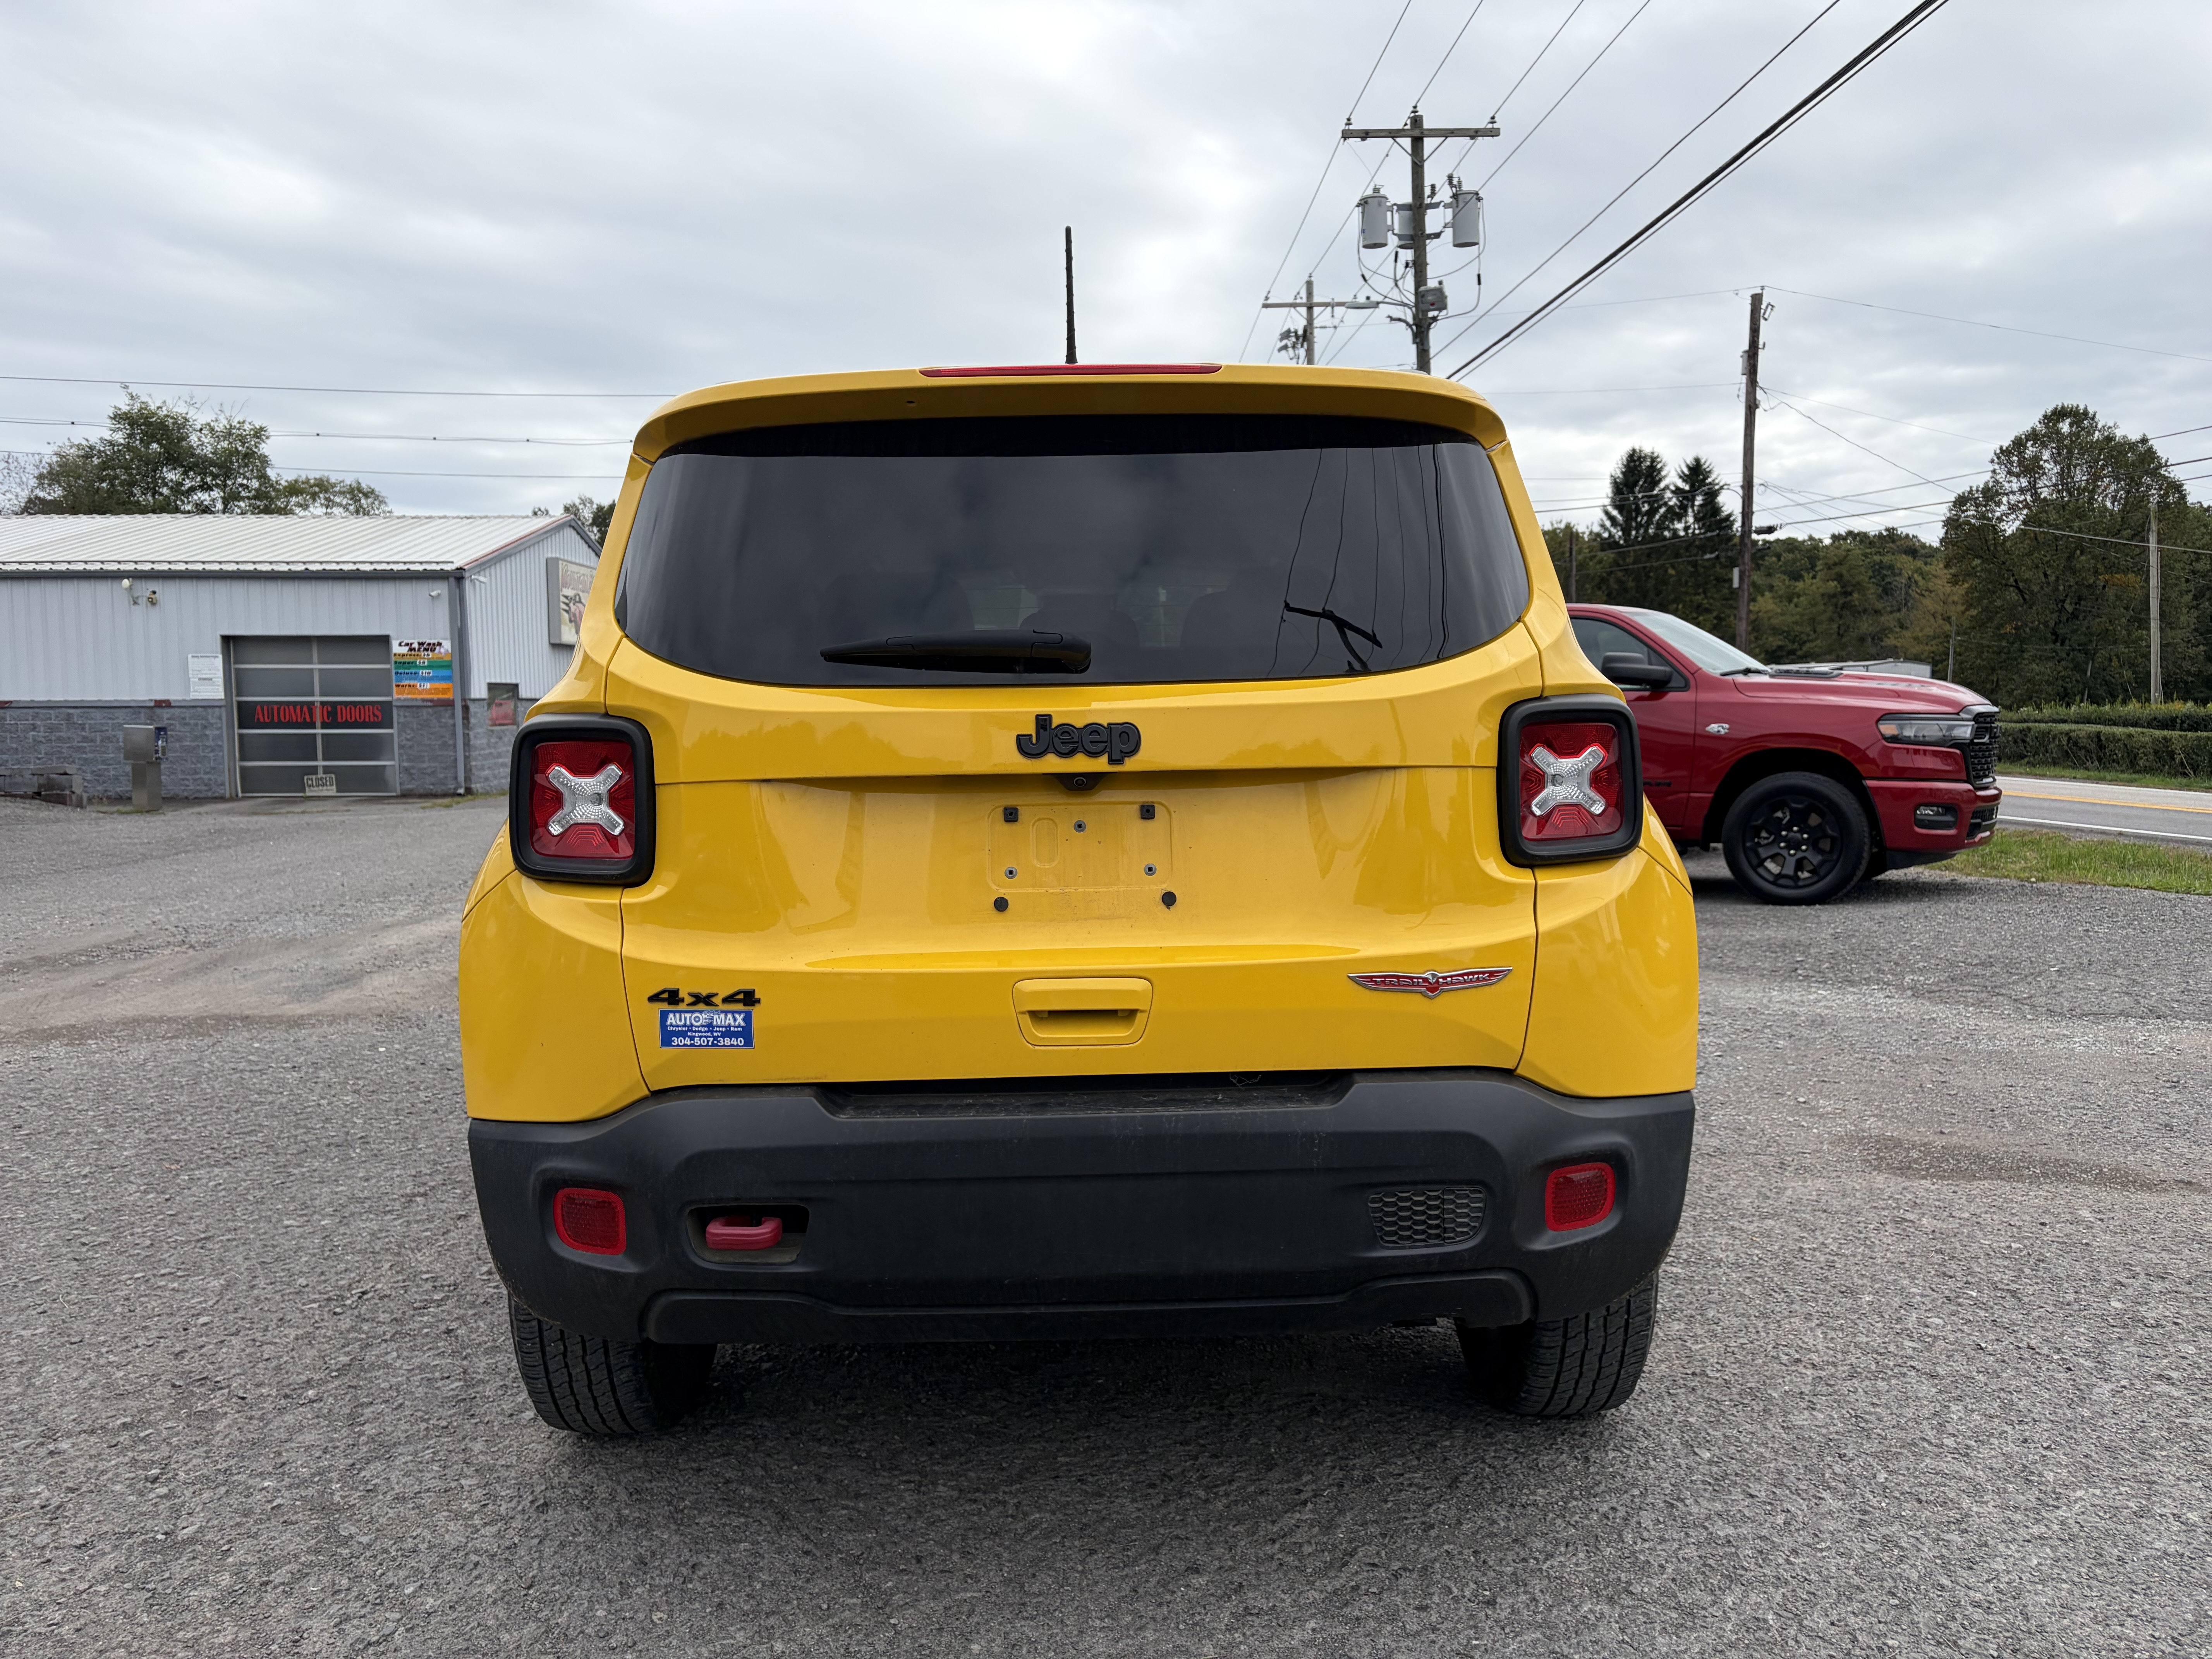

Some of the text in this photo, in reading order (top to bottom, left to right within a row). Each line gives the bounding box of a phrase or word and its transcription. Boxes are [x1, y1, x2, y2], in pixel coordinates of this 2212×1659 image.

[254, 705, 381, 723] AUTOMATIC DOORS
[1016, 714, 1141, 765] Jeep
[306, 776, 334, 788] CLOSED
[647, 988, 761, 1006] 4x4
[666, 1012, 746, 1026] AUTO MAX
[672, 1037, 744, 1046] 304-507-3840
